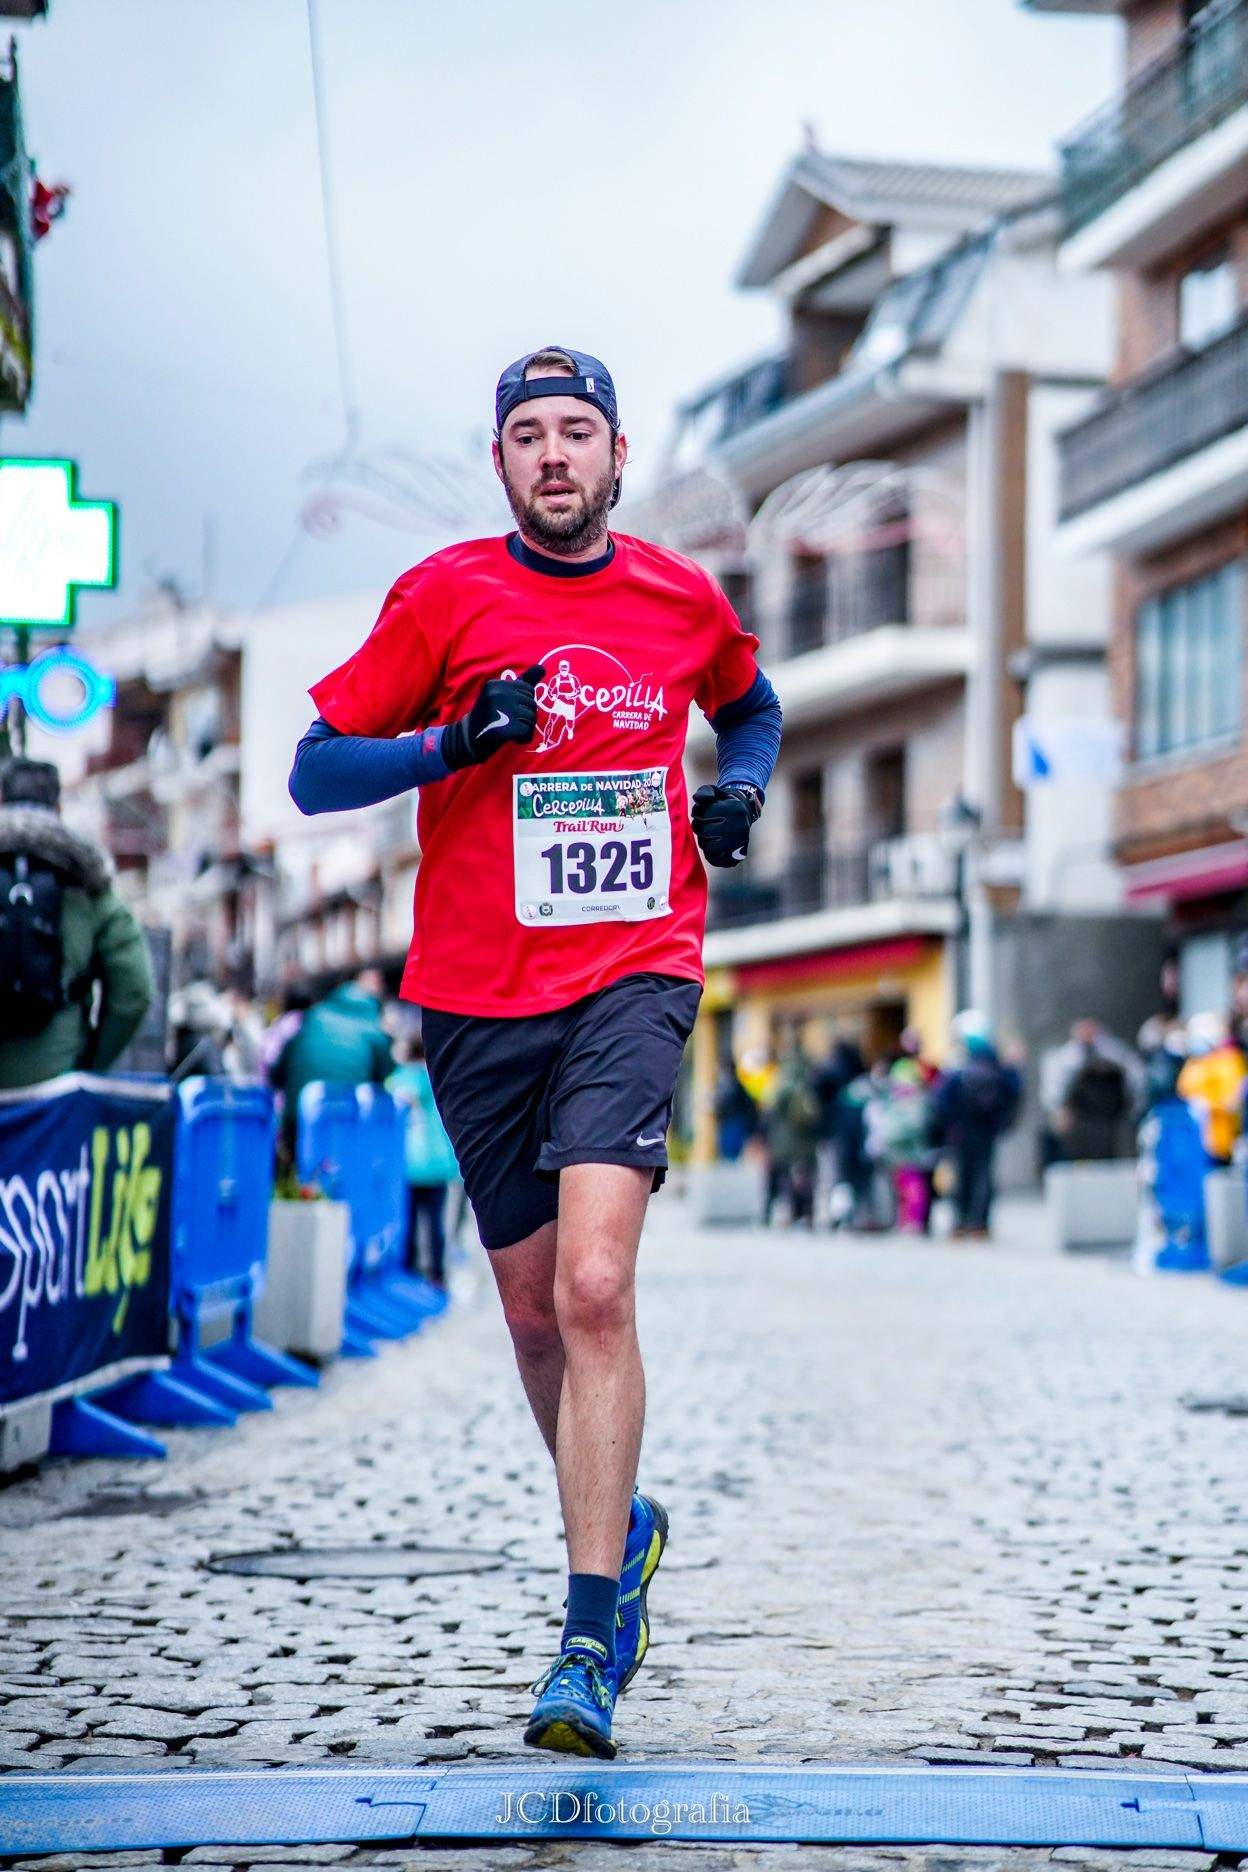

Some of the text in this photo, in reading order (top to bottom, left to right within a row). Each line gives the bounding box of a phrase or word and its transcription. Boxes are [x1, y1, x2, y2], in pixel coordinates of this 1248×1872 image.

[612, 710, 653, 722] CARRERA DE
[612, 719, 650, 731] NAVIDAD
[532, 781, 578, 793] ARRERA
[580, 783, 594, 792] DE
[595, 779, 641, 791] NAVIDAD
[553, 820, 624, 834] Trail Run
[541, 838, 653, 894] 1325
